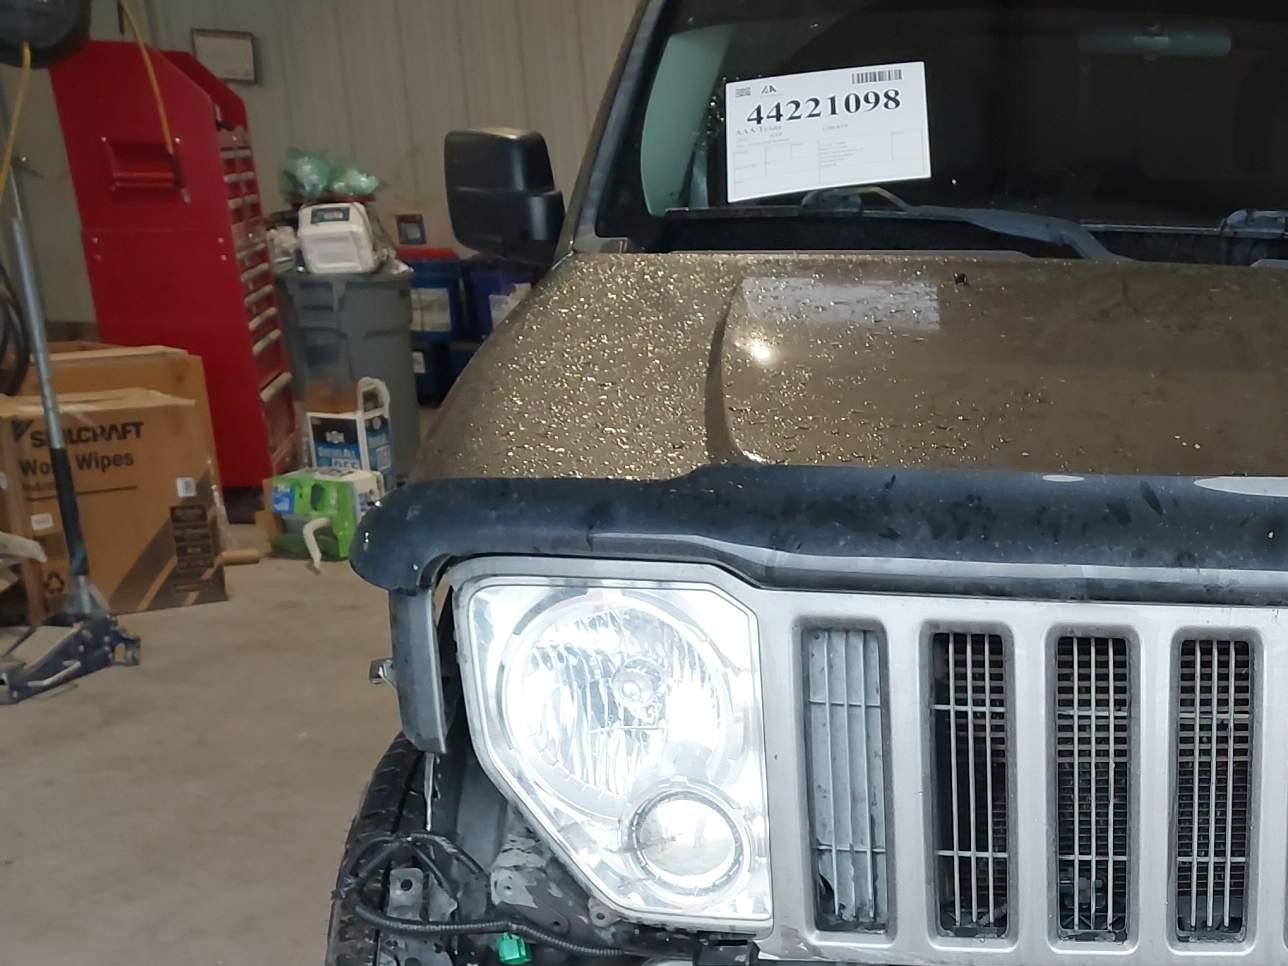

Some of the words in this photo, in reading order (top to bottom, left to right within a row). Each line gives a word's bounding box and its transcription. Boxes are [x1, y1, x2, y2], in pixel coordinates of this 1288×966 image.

[747, 89, 902, 125] 44221098
[30, 421, 144, 448] SILCRAFT
[75, 452, 134, 472] Wipes
